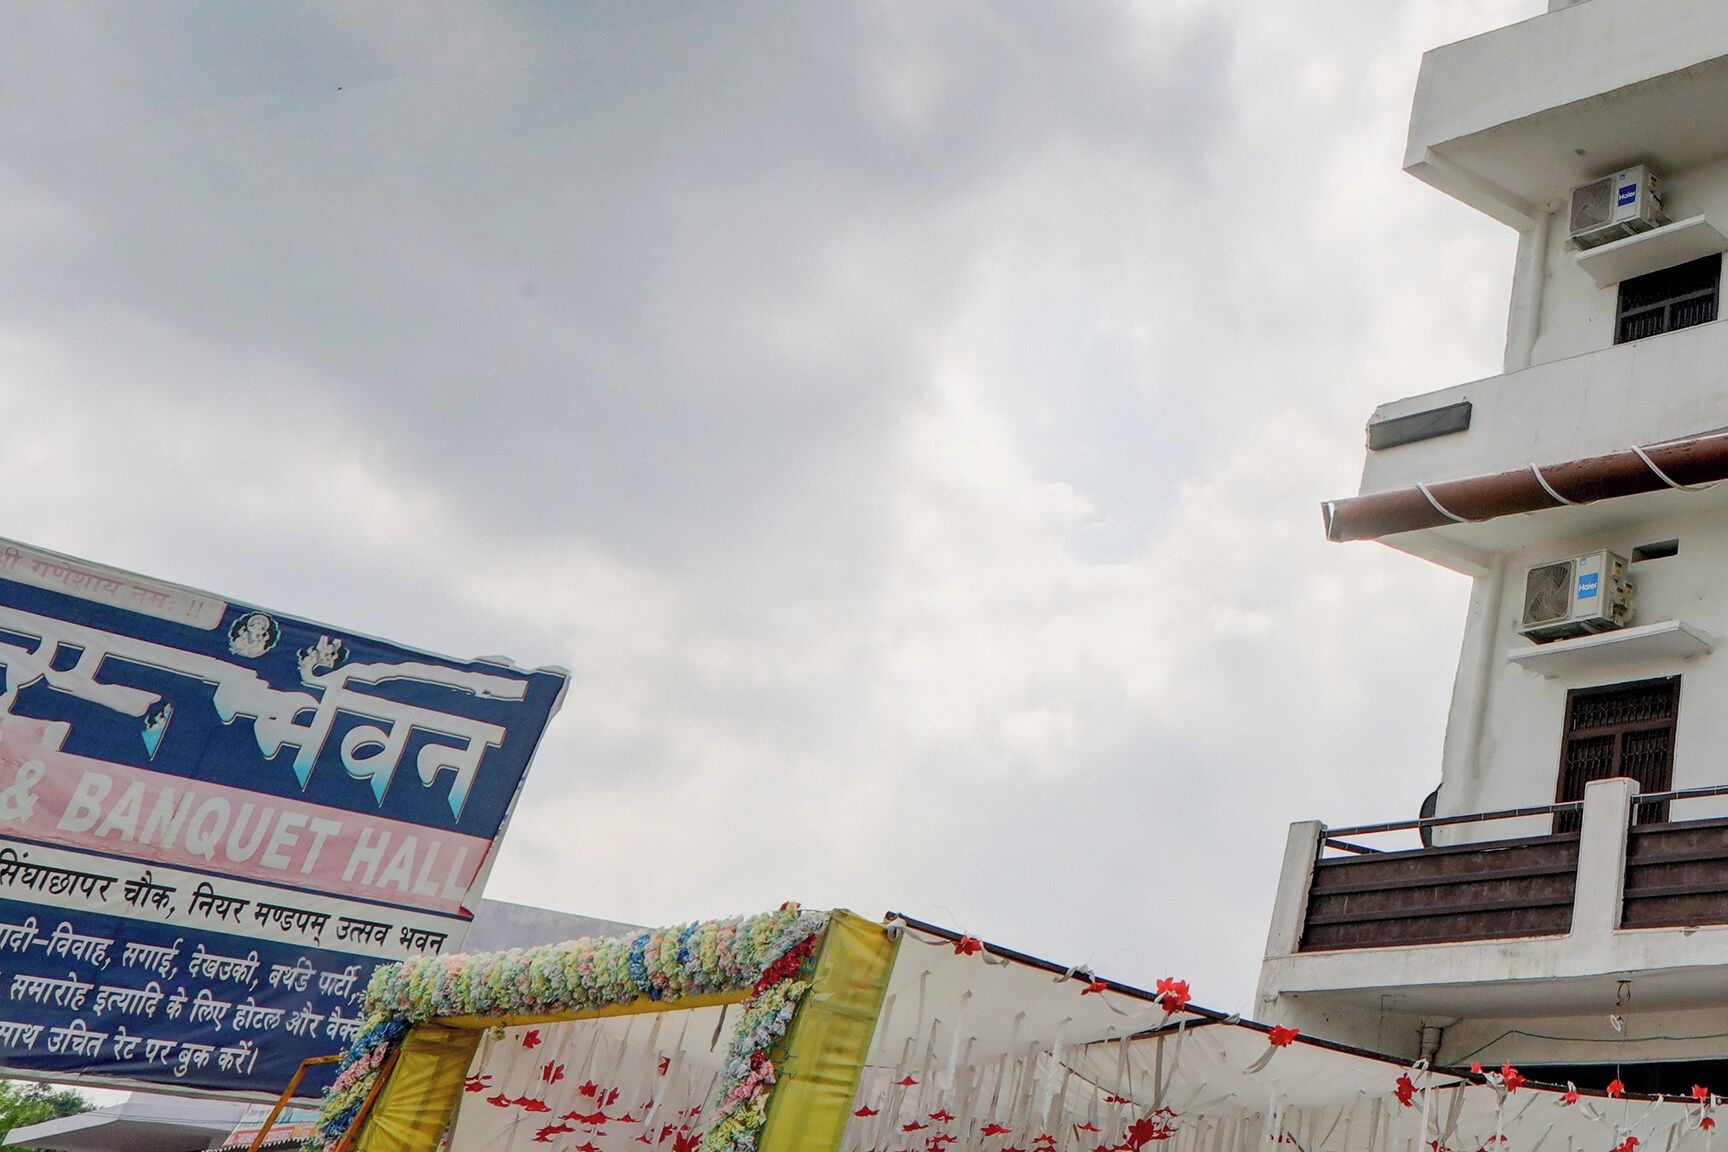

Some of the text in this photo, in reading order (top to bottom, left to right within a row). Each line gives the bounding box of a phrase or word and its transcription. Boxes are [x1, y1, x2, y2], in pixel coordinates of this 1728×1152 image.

[31, 559, 125, 596] गणेशाय
[1578, 581, 1598, 592] Haier
[0, 759, 468, 903] & BANQUET HALL
[123, 870, 177, 919] चौक,
[188, 882, 250, 924] नियर
[254, 903, 331, 947] मण्डपम्
[336, 917, 394, 947] उत्सव
[400, 926, 448, 956] भवन
[0, 916, 115, 971] ादी-विवाह,
[122, 938, 184, 980] सगाई,
[10, 972, 95, 1011] समारोह
[92, 981, 165, 1018] इत्यादि
[166, 987, 189, 1021] के
[189, 989, 232, 1032] लिए
[232, 997, 286, 1032] होटल
[286, 1001, 325, 1038] और
[48, 1018, 109, 1059] उचित
[113, 1026, 142, 1061] रेट
[146, 1037, 178, 1066] पर
[173, 1042, 215, 1078] बुक
